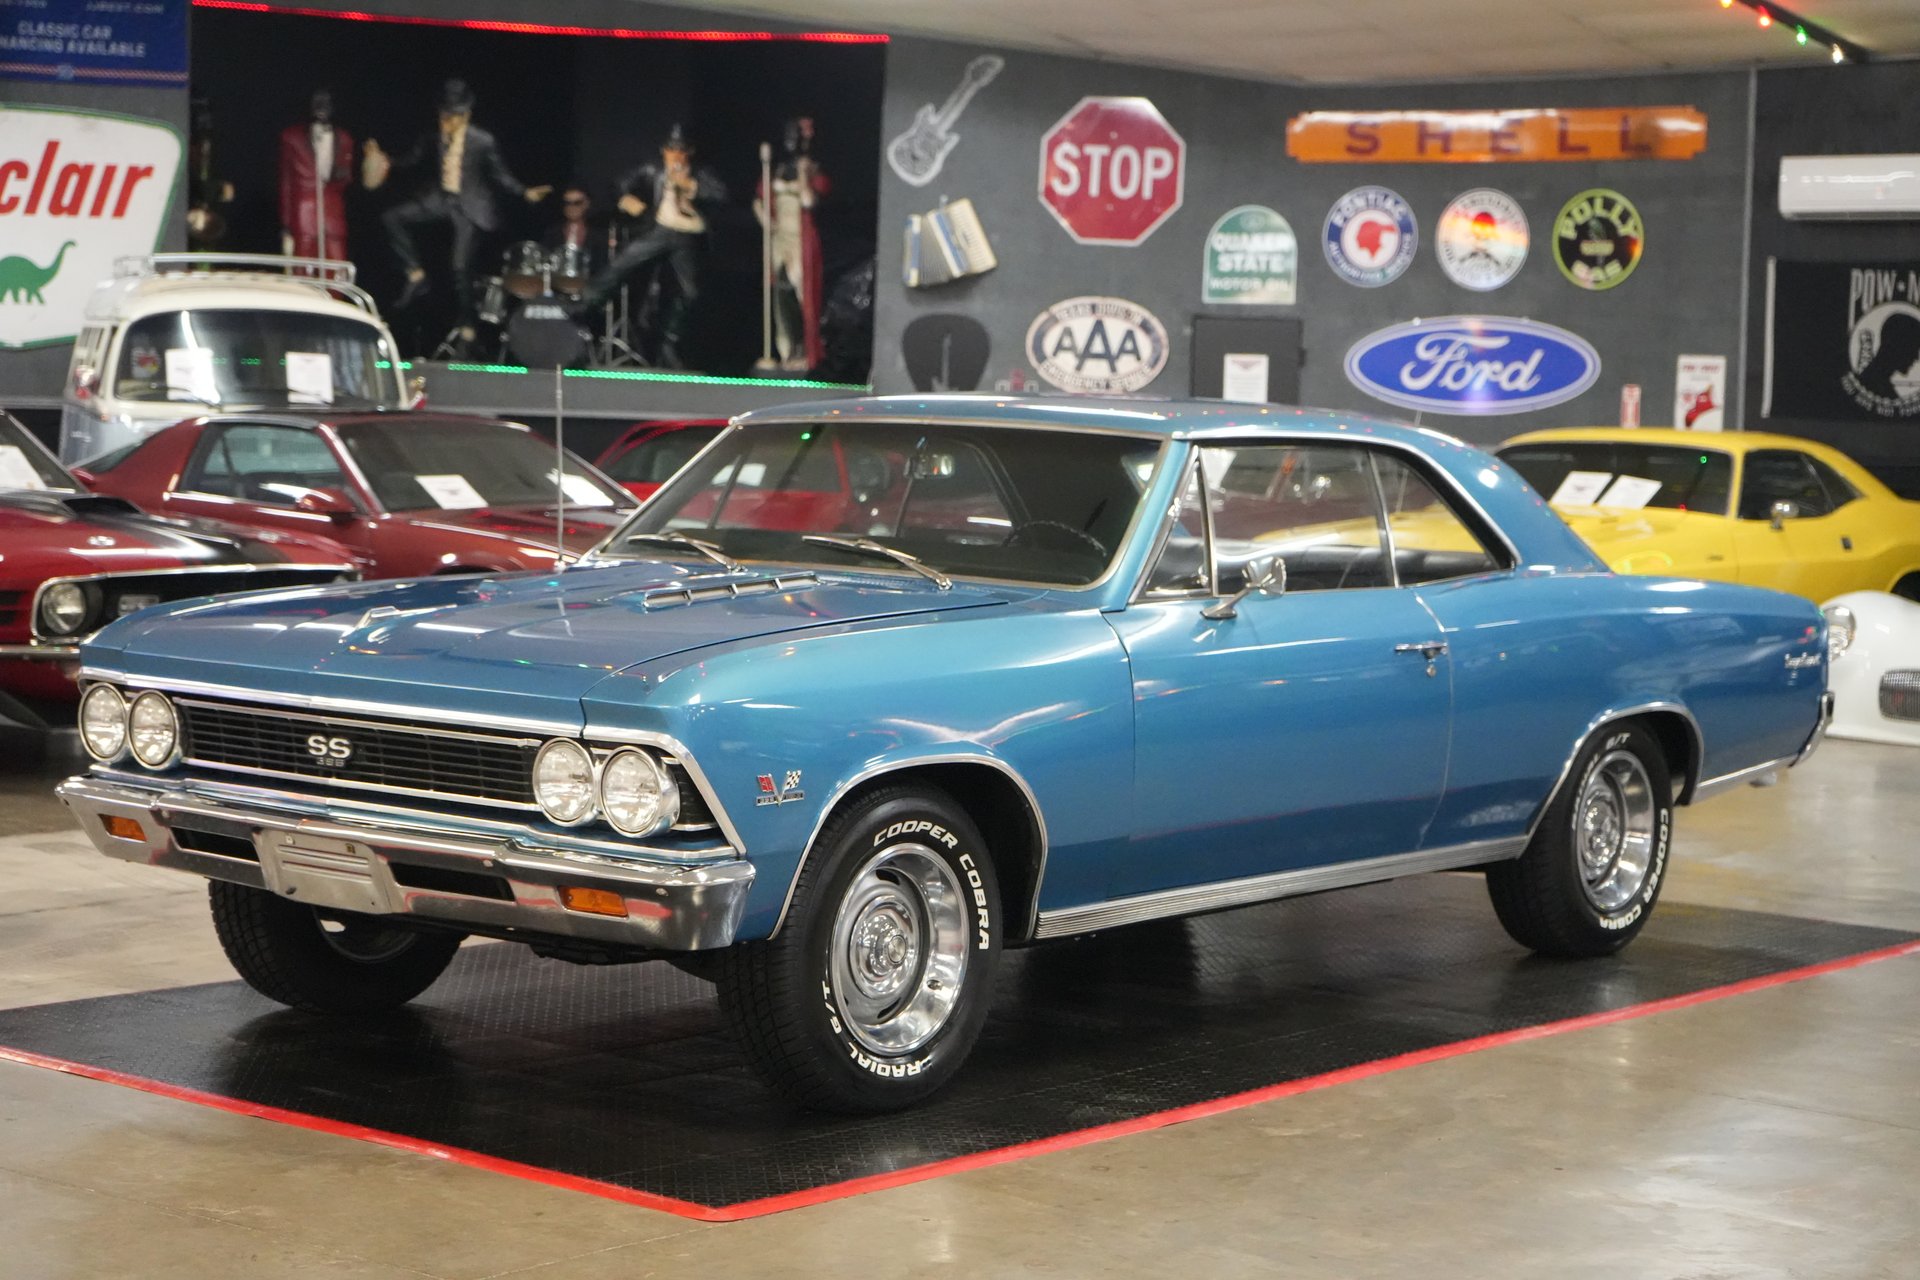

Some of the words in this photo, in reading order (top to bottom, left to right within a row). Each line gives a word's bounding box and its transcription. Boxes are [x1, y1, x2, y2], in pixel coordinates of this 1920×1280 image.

[18, 20, 79, 38] CLASSIC
[82, 24, 112, 40] CAR
[67, 40, 146, 57] AVAILABLE
[1345, 115, 1652, 156] SHELL
[1051, 142, 1174, 201] STOP
[1330, 191, 1407, 227] PONTIAC
[1560, 197, 1640, 240] POLLY
[1217, 253, 1285, 273] STATE
[1571, 259, 1623, 283] GAS
[1209, 277, 1263, 291] MOTOR
[1848, 267, 1898, 335] POW
[1052, 318, 1142, 373] AAA
[1399, 331, 1544, 393] Ford
[307, 735, 351, 759] SS
[1642, 808, 1669, 904] COOPER
[873, 820, 959, 849] COOPER
[959, 853, 990, 950] COBRA
[1600, 903, 1642, 930] COBRA
[821, 980, 842, 1035] G/T
[848, 1041, 930, 1078] RADIAL
